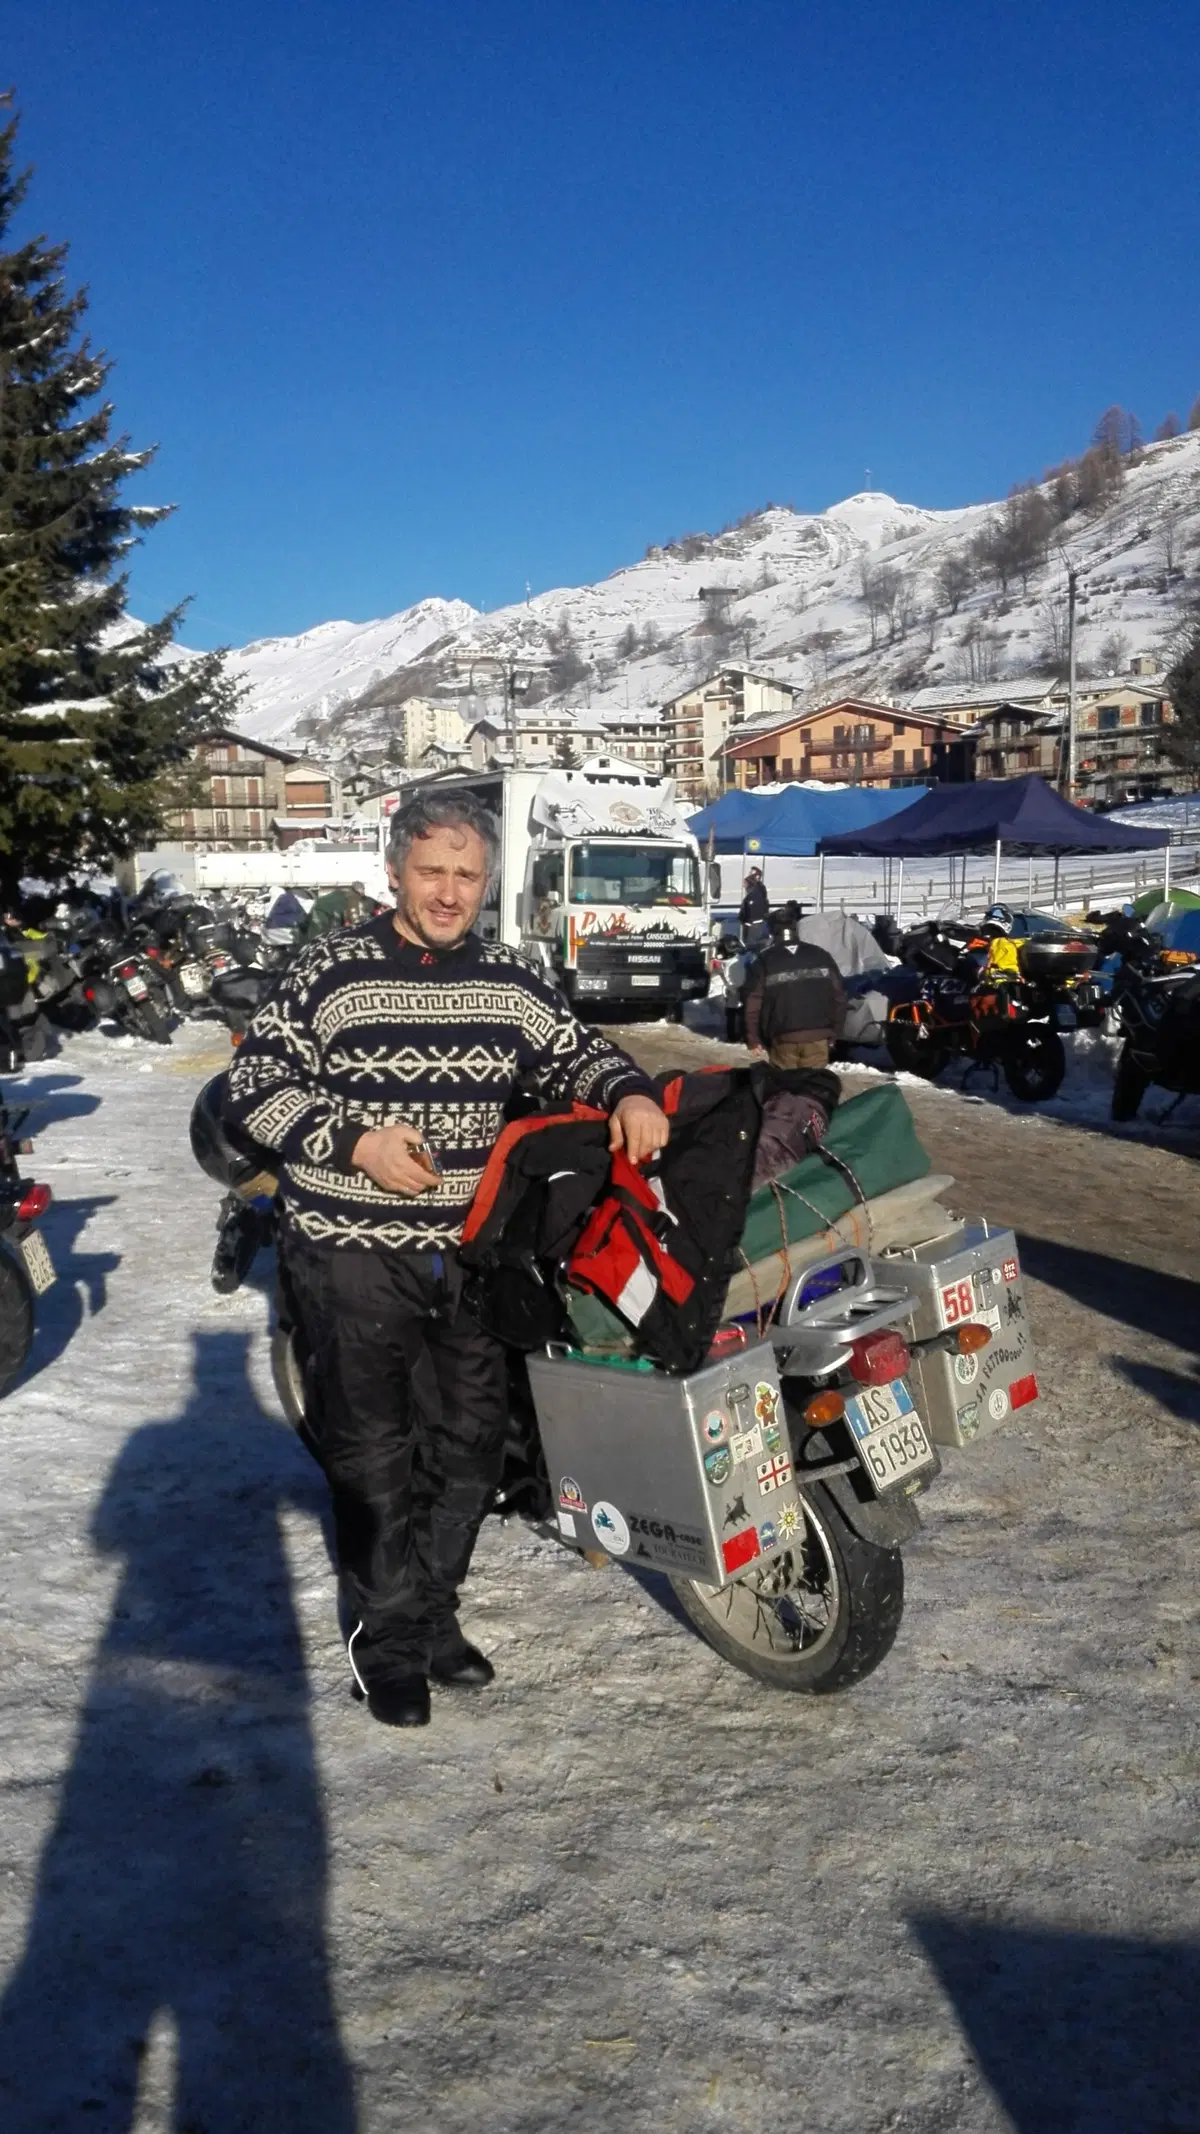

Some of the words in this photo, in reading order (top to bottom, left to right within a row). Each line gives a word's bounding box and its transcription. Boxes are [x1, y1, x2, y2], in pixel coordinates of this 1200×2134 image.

[628, 955, 661, 963] NISSAN
[1005, 1271, 1016, 1279] TAL
[942, 1281, 973, 1324] 58
[862, 1389, 890, 1429] AS
[867, 1422, 928, 1477] 61939
